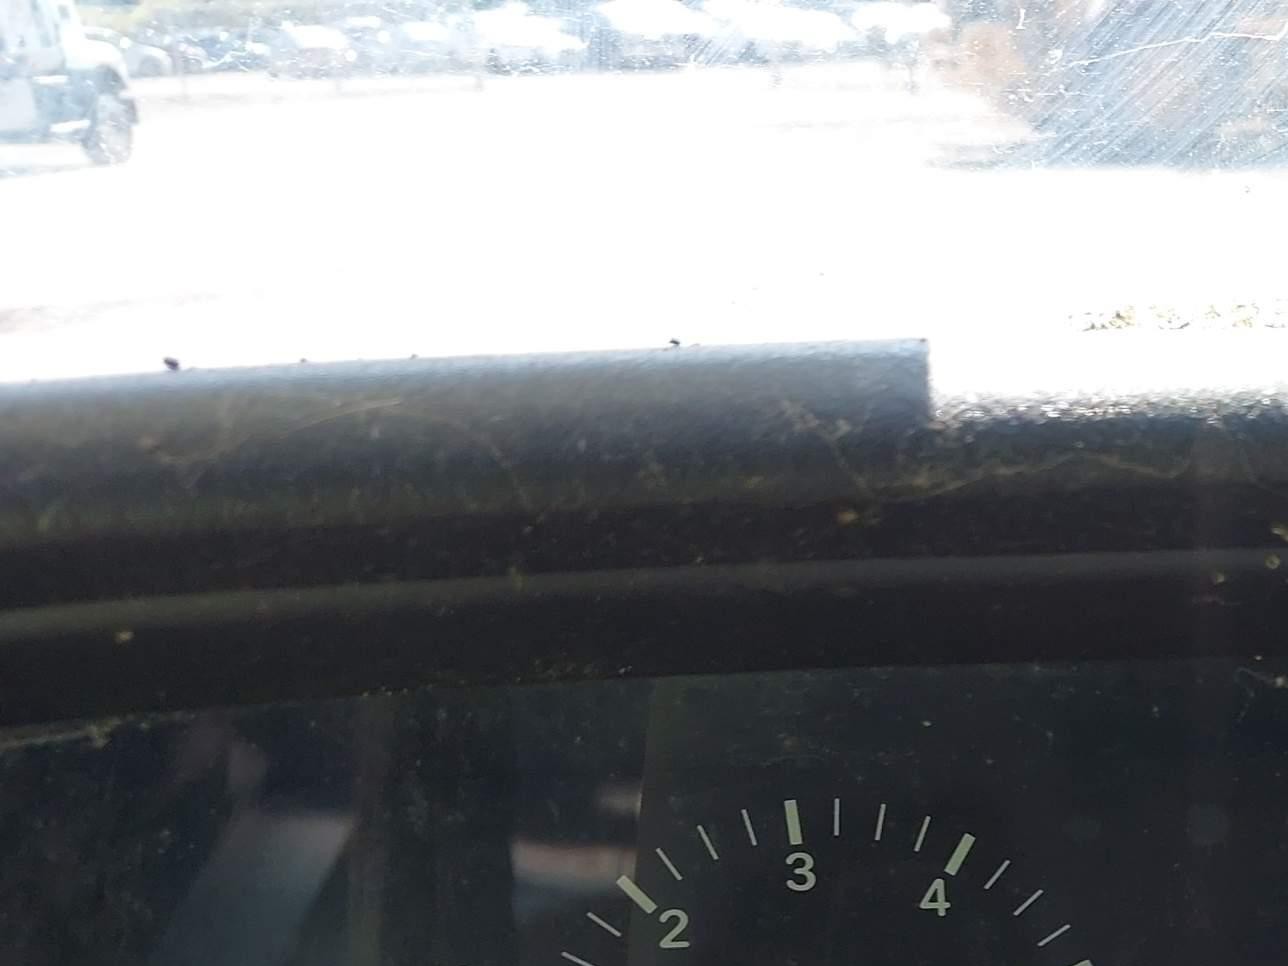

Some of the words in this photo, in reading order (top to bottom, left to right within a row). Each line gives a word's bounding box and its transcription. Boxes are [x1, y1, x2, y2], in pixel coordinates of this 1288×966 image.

[786, 853, 816, 892] 3
[919, 879, 951, 916] 4
[659, 910, 690, 948] 2
